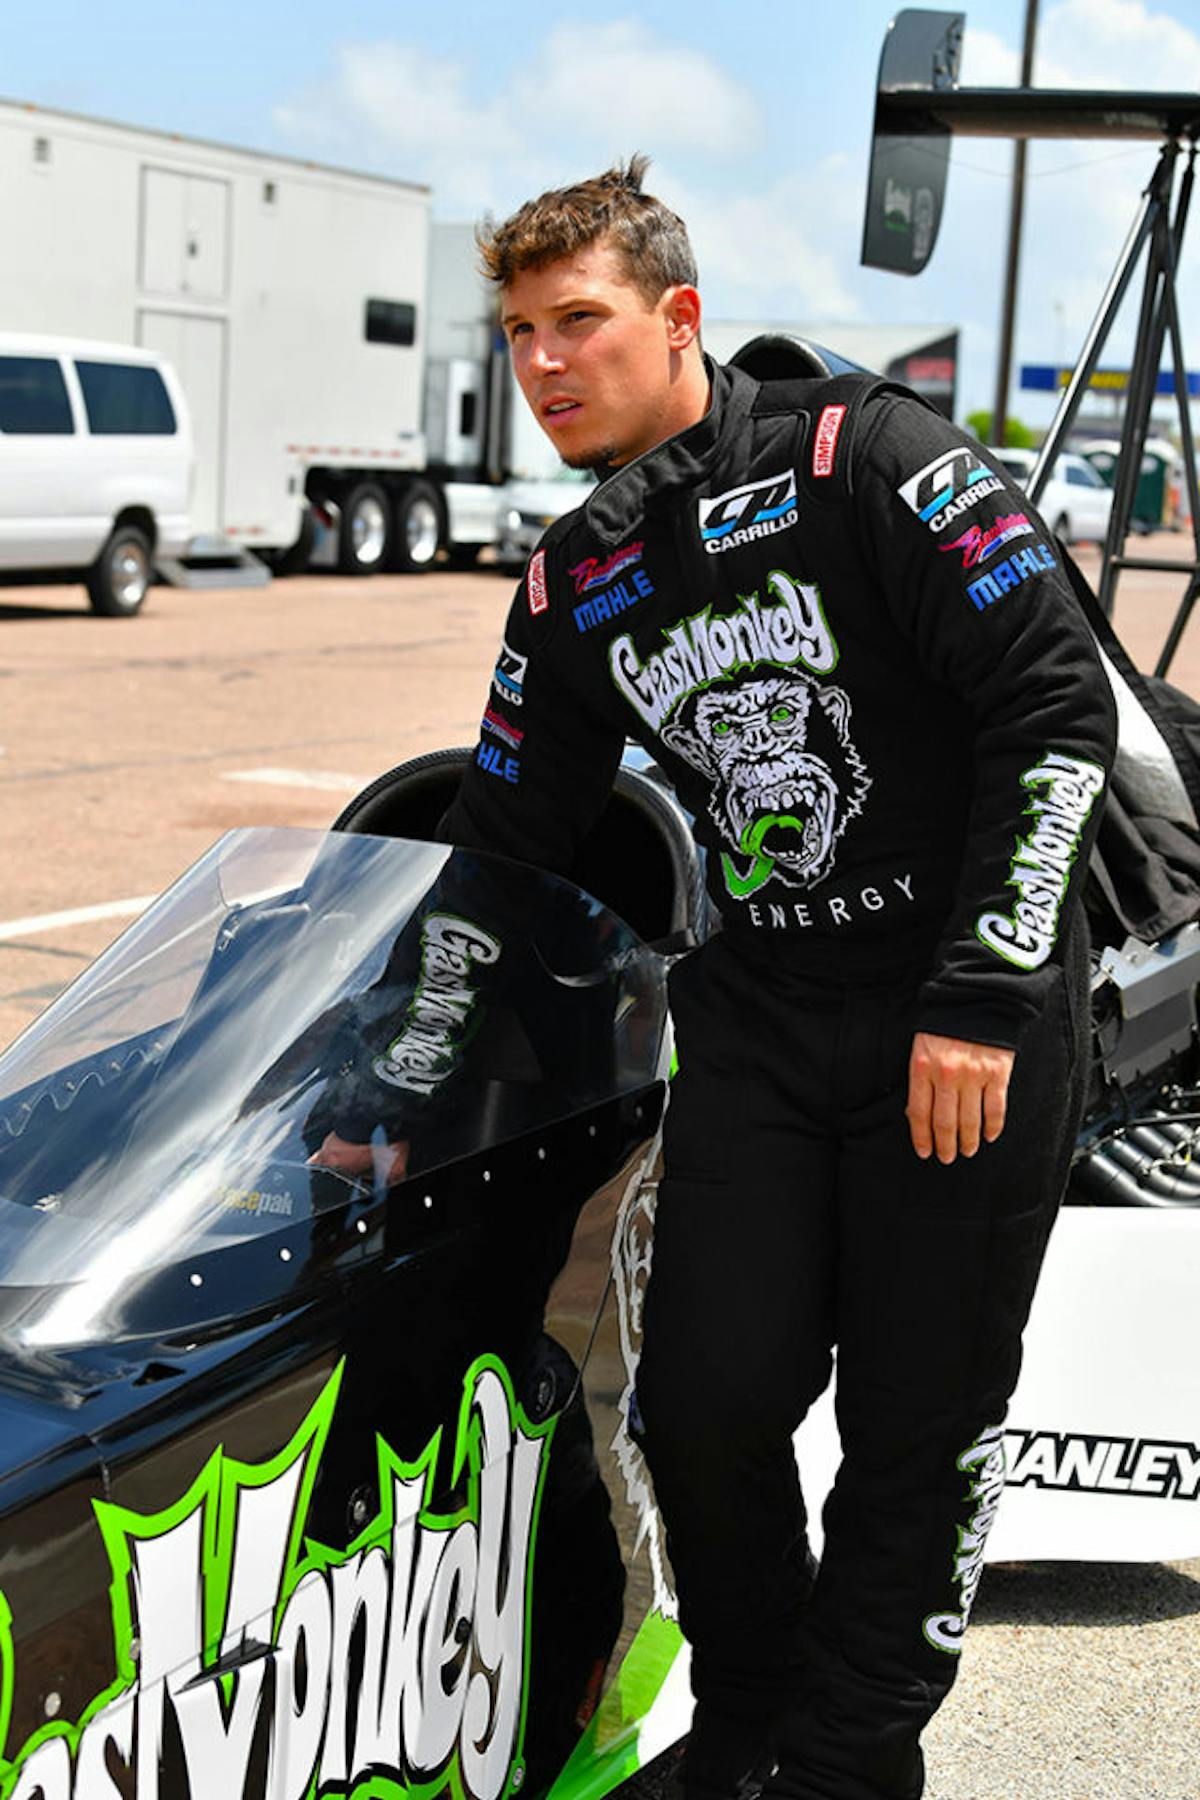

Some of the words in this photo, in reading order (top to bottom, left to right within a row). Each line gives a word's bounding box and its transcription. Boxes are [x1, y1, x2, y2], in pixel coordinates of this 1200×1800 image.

[817, 411, 839, 472] SIMPSON
[705, 509, 798, 555] CARRILLO
[573, 569, 655, 633] MAHLE
[967, 544, 1057, 611] MAHLE
[750, 874, 914, 929] ENERGY
[218, 1187, 293, 1217] acepak
